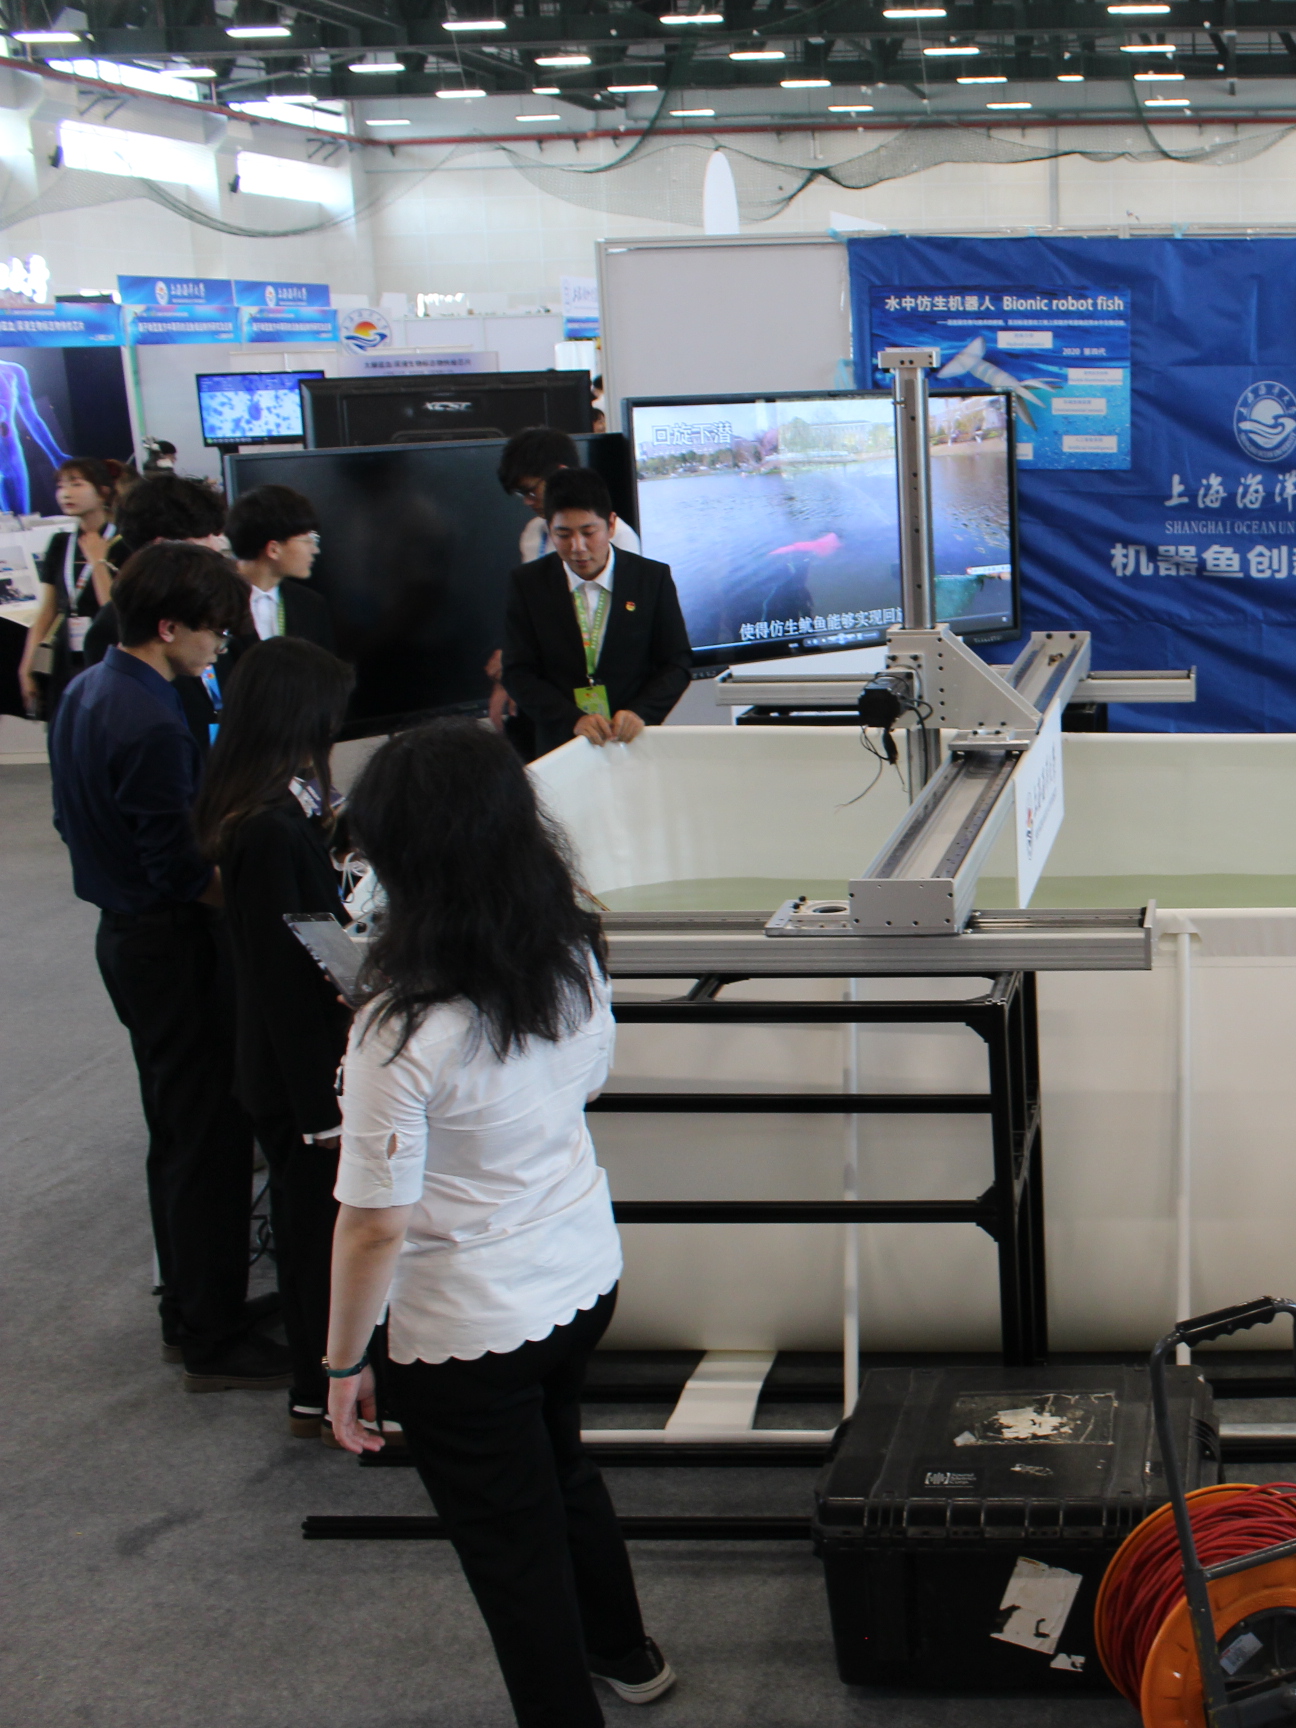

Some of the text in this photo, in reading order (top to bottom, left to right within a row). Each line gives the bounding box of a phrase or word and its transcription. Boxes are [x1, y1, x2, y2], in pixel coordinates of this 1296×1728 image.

[885, 295, 1124, 312] 水中仿生机器人 Bionic robot fish
[651, 420, 733, 446] 回旋下潜
[1164, 520, 1232, 535] SHANGHAI
[1234, 520, 1277, 535] OCEAN
